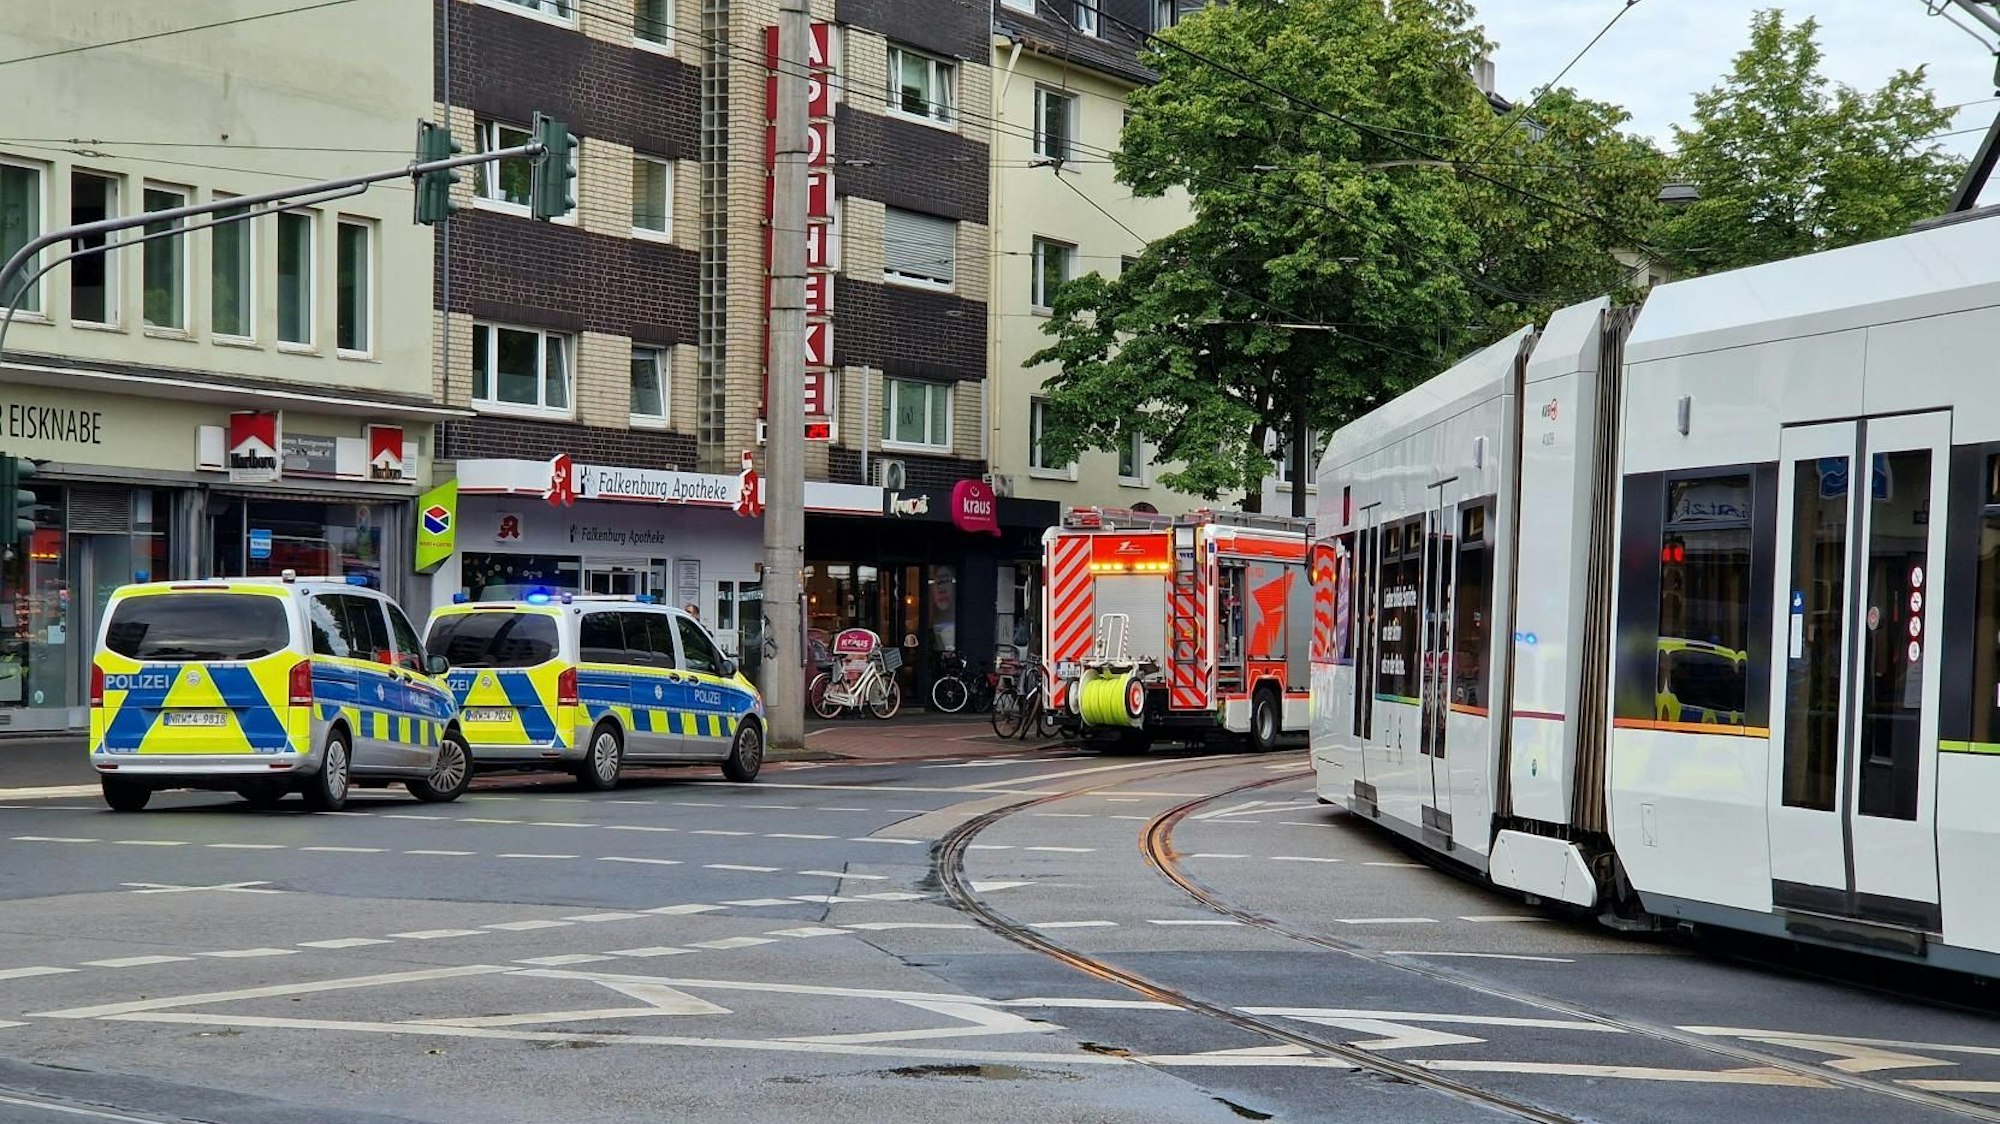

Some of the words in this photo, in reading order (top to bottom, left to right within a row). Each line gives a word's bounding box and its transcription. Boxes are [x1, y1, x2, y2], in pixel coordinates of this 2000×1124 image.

[9, 404, 102, 444] EISKNABE
[598, 471, 668, 501] Falkenburg
[672, 476, 728, 503] Apotheke
[963, 497, 991, 515] kraus
[581, 526, 626, 545] Falkenburg
[627, 529, 665, 546] Apotheke
[105, 674, 169, 690] POLIZEI
[694, 688, 721, 705] POLIZEI
